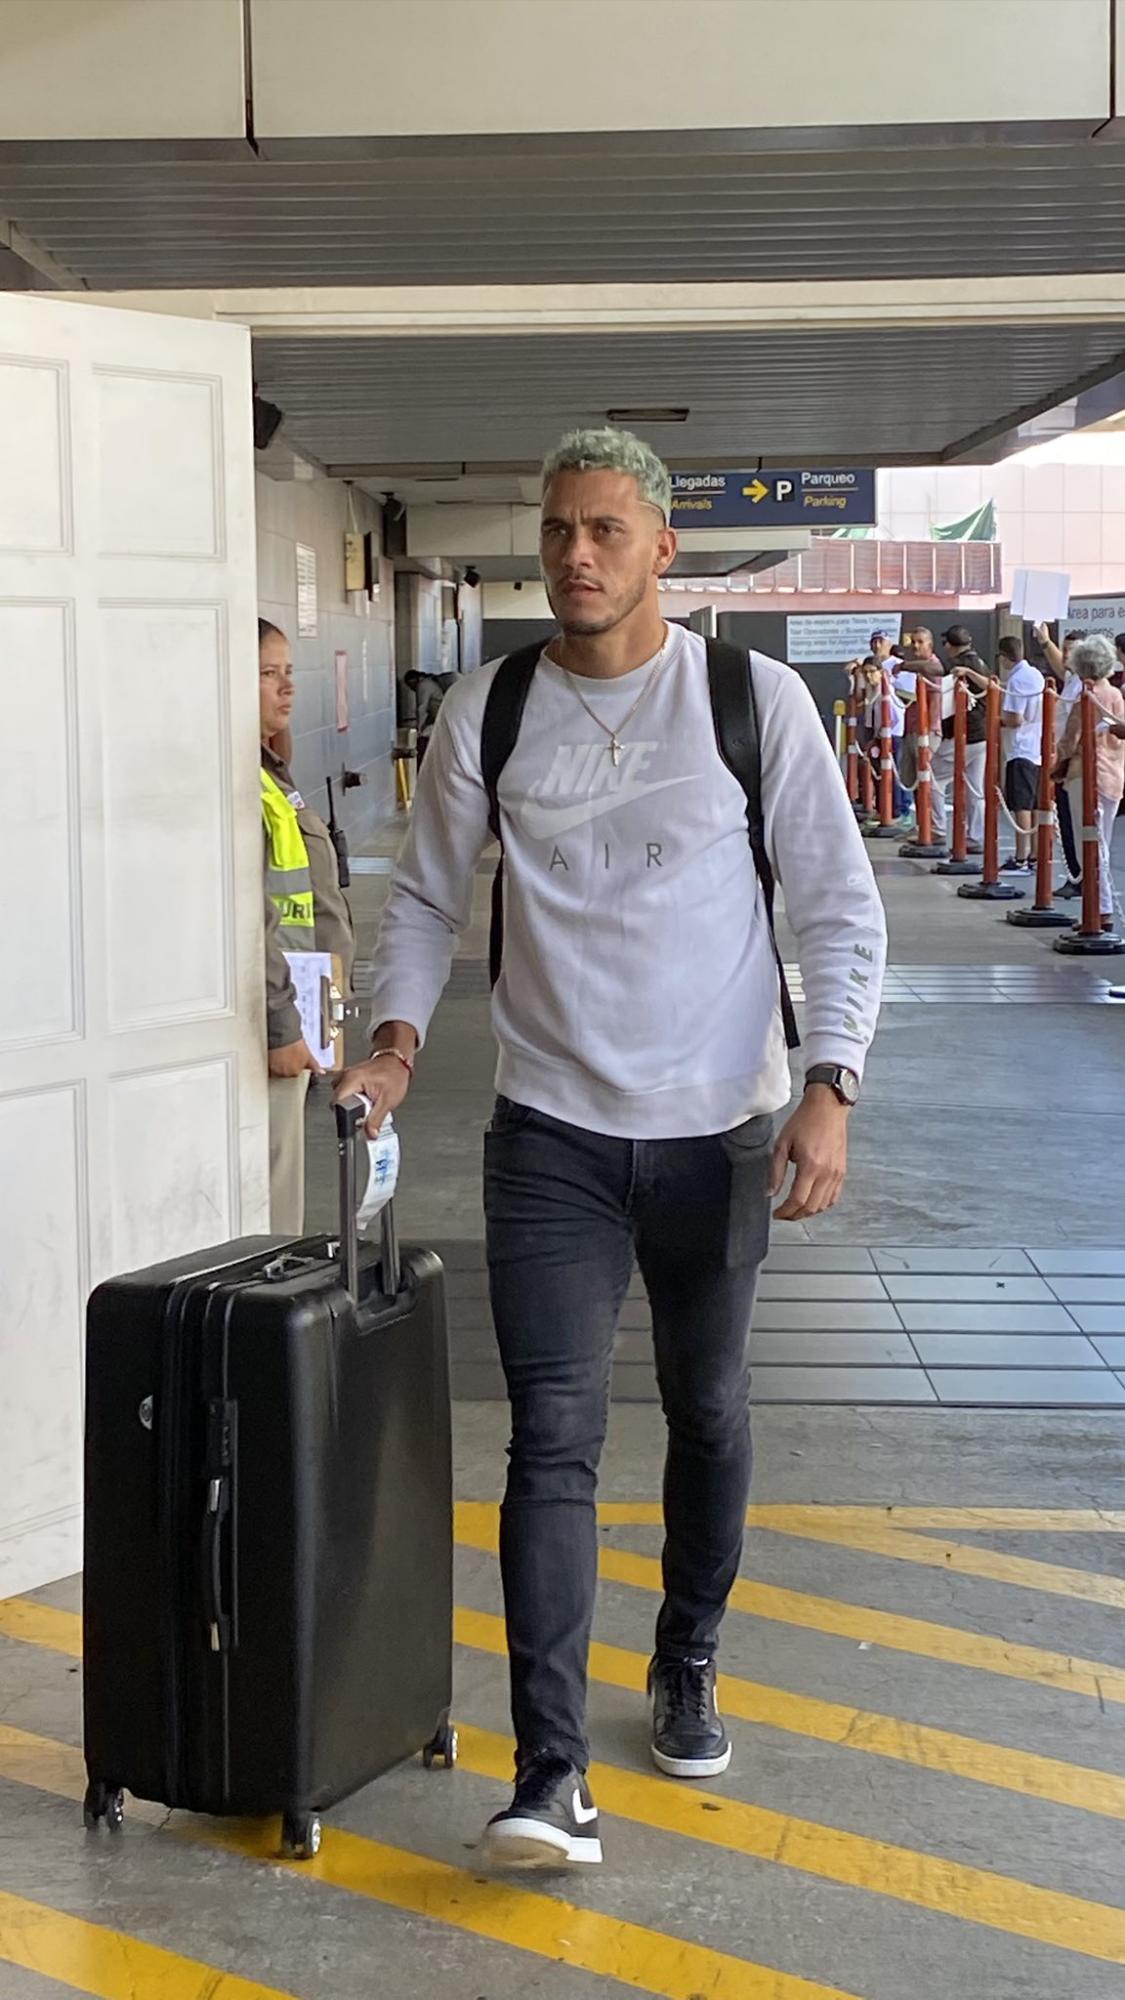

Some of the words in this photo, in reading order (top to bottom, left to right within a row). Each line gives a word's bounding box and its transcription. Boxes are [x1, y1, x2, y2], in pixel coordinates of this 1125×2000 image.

[669, 474, 726, 490] Llegadas
[801, 471, 856, 486] Parqueo
[776, 480, 793, 501] P
[671, 498, 713, 510] Arrivals
[803, 495, 847, 509] Parking
[1092, 607, 1115, 621] para
[539, 741, 660, 797] NIKE
